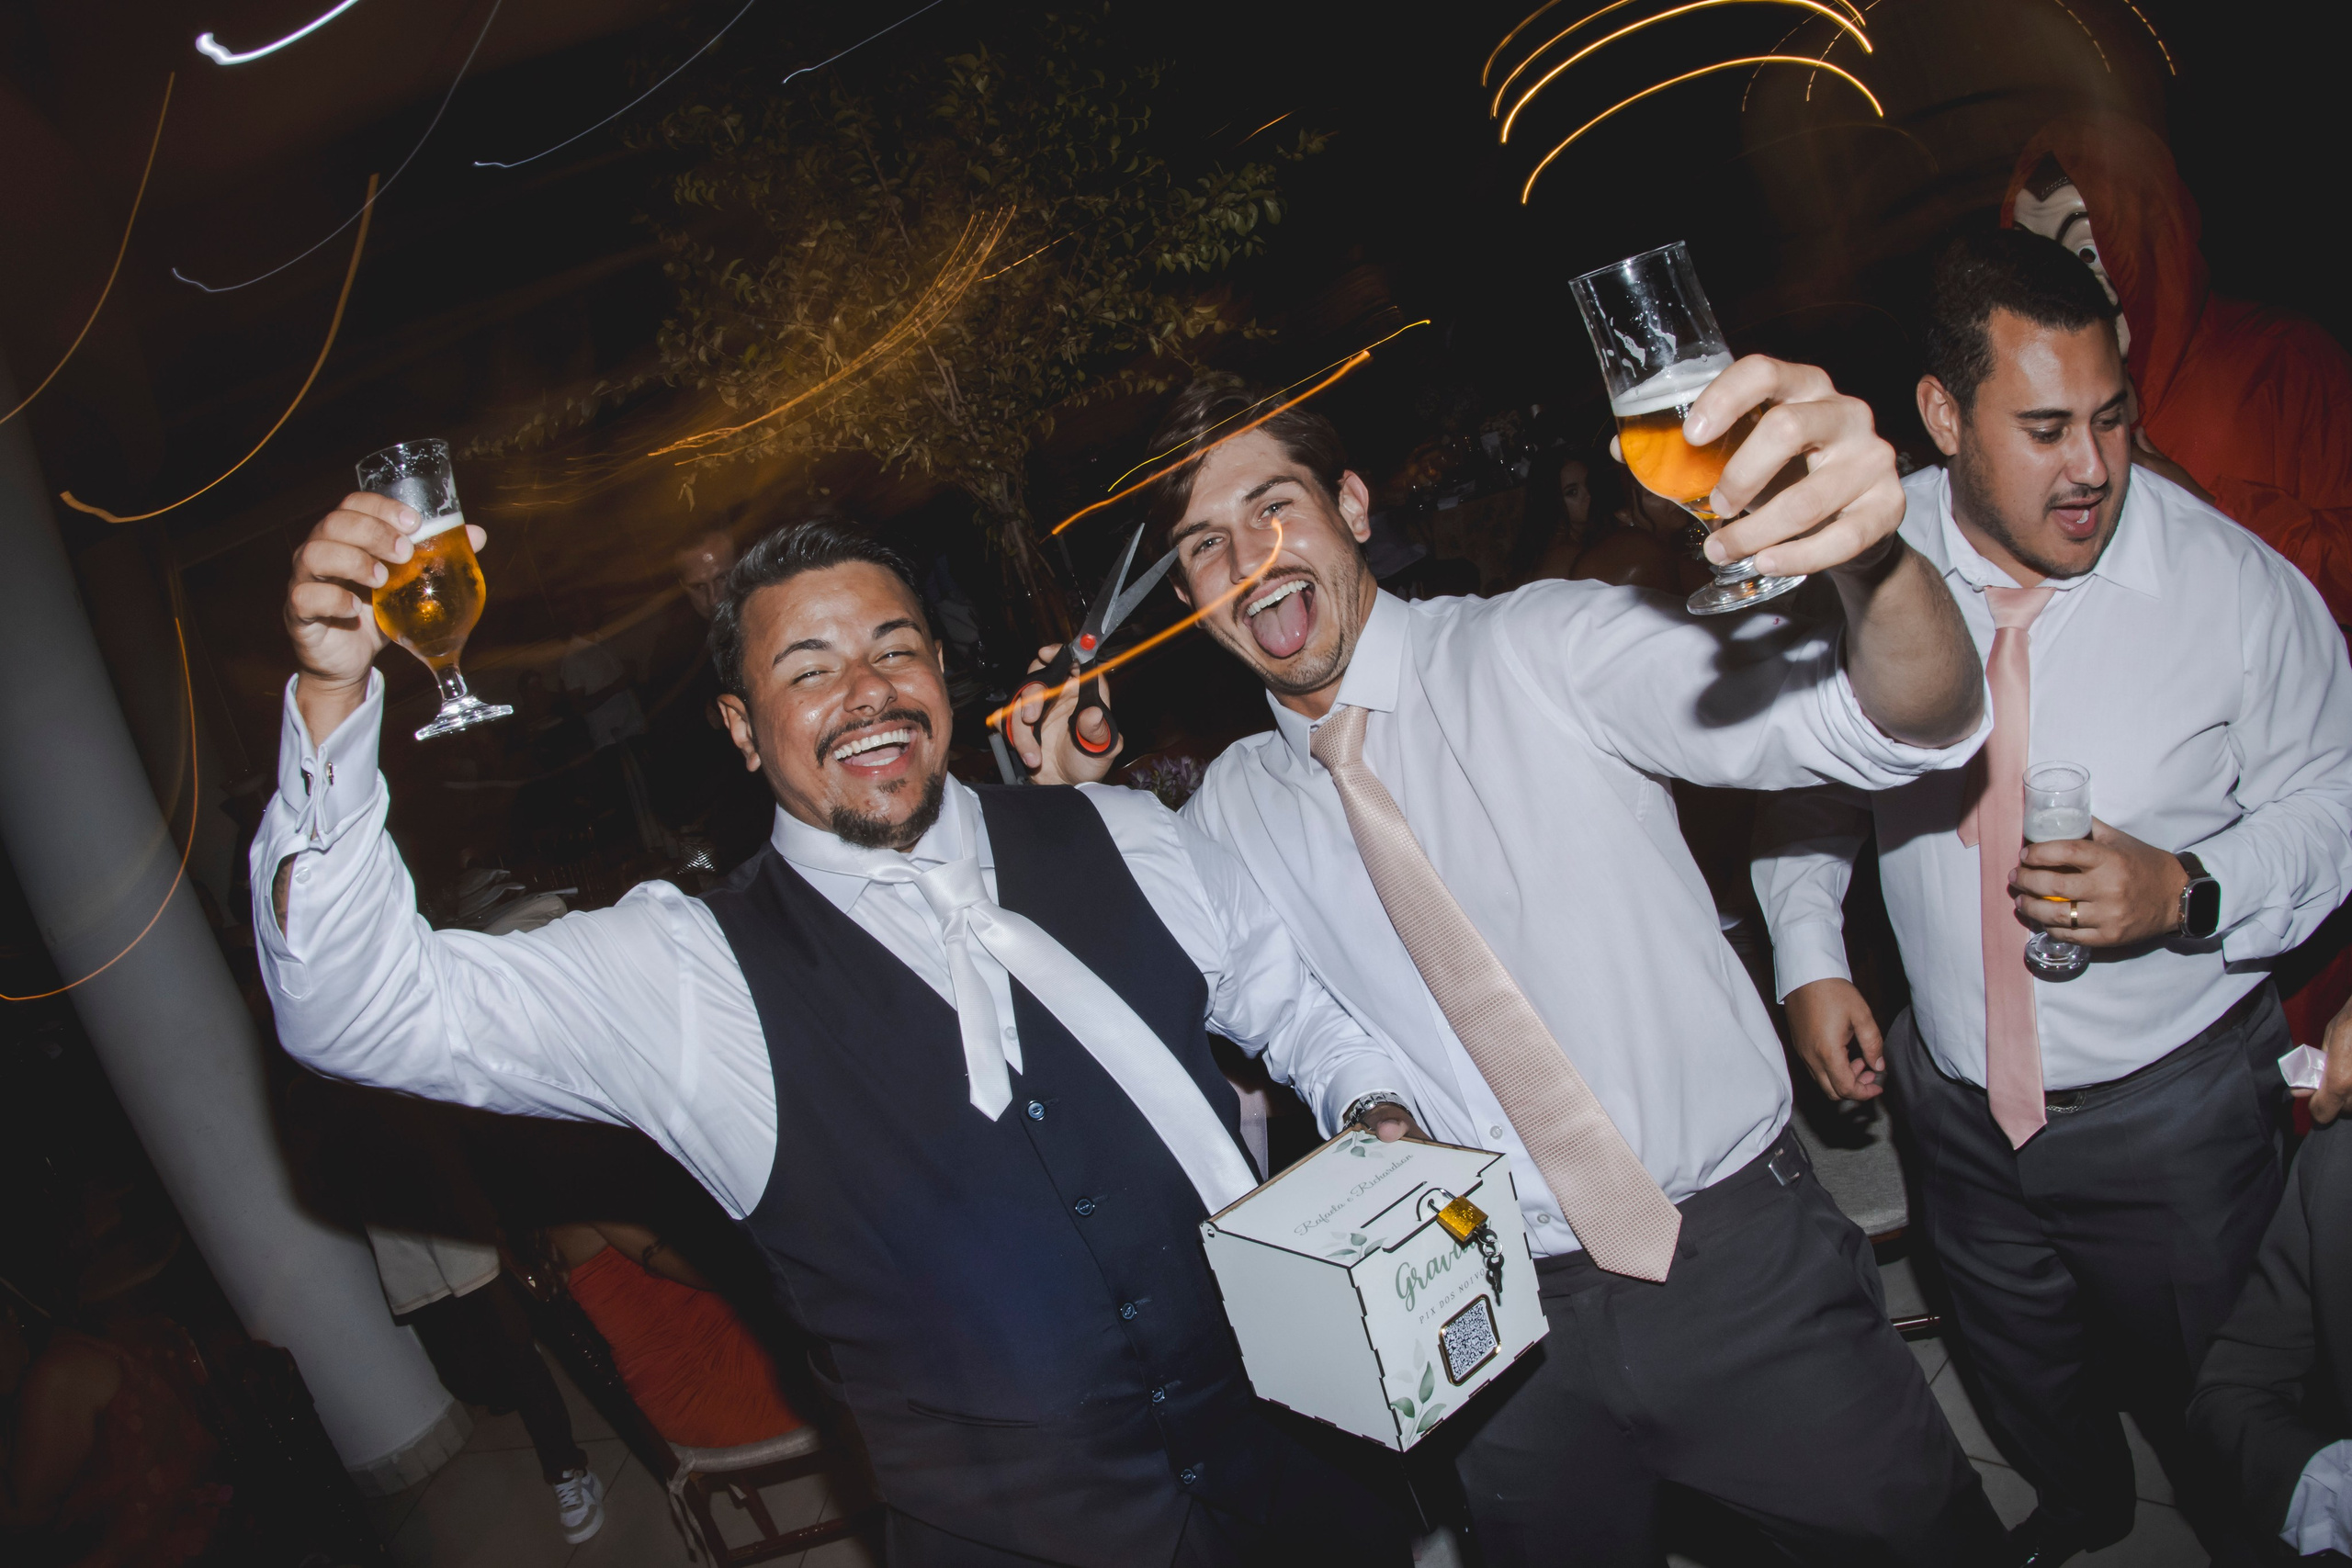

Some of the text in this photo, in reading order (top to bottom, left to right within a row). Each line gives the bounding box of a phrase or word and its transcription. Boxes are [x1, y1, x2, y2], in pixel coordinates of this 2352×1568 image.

[1294, 1202, 1345, 1235] Rafaela
[1351, 1154, 1413, 1196] Richardson
[1419, 1268, 1485, 1325] PIX DOS NOIVO
